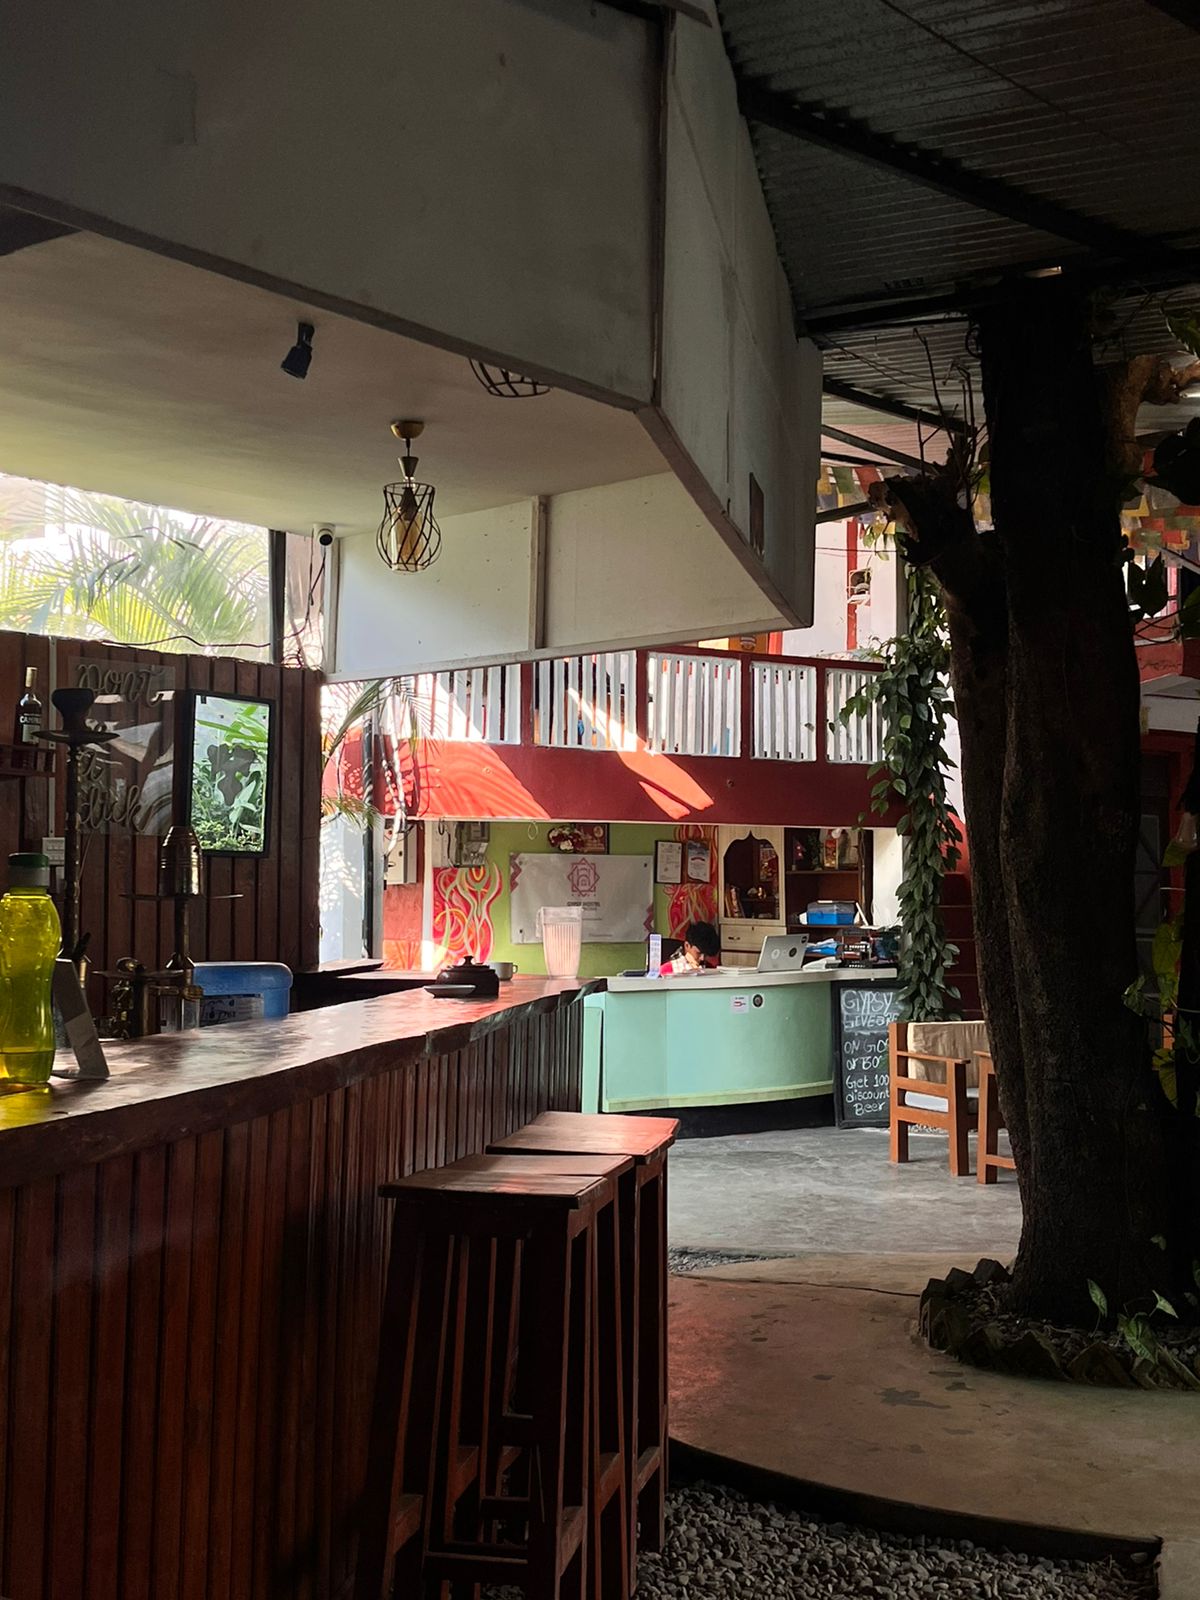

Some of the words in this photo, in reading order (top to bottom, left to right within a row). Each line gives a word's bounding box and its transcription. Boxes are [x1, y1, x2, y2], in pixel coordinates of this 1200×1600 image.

[841, 990, 893, 1016] GYPSY
[846, 1075, 869, 1089] Get
[873, 1074, 890, 1087] 100
[846, 1088, 890, 1103] discount
[853, 1102, 886, 1116] Beer
